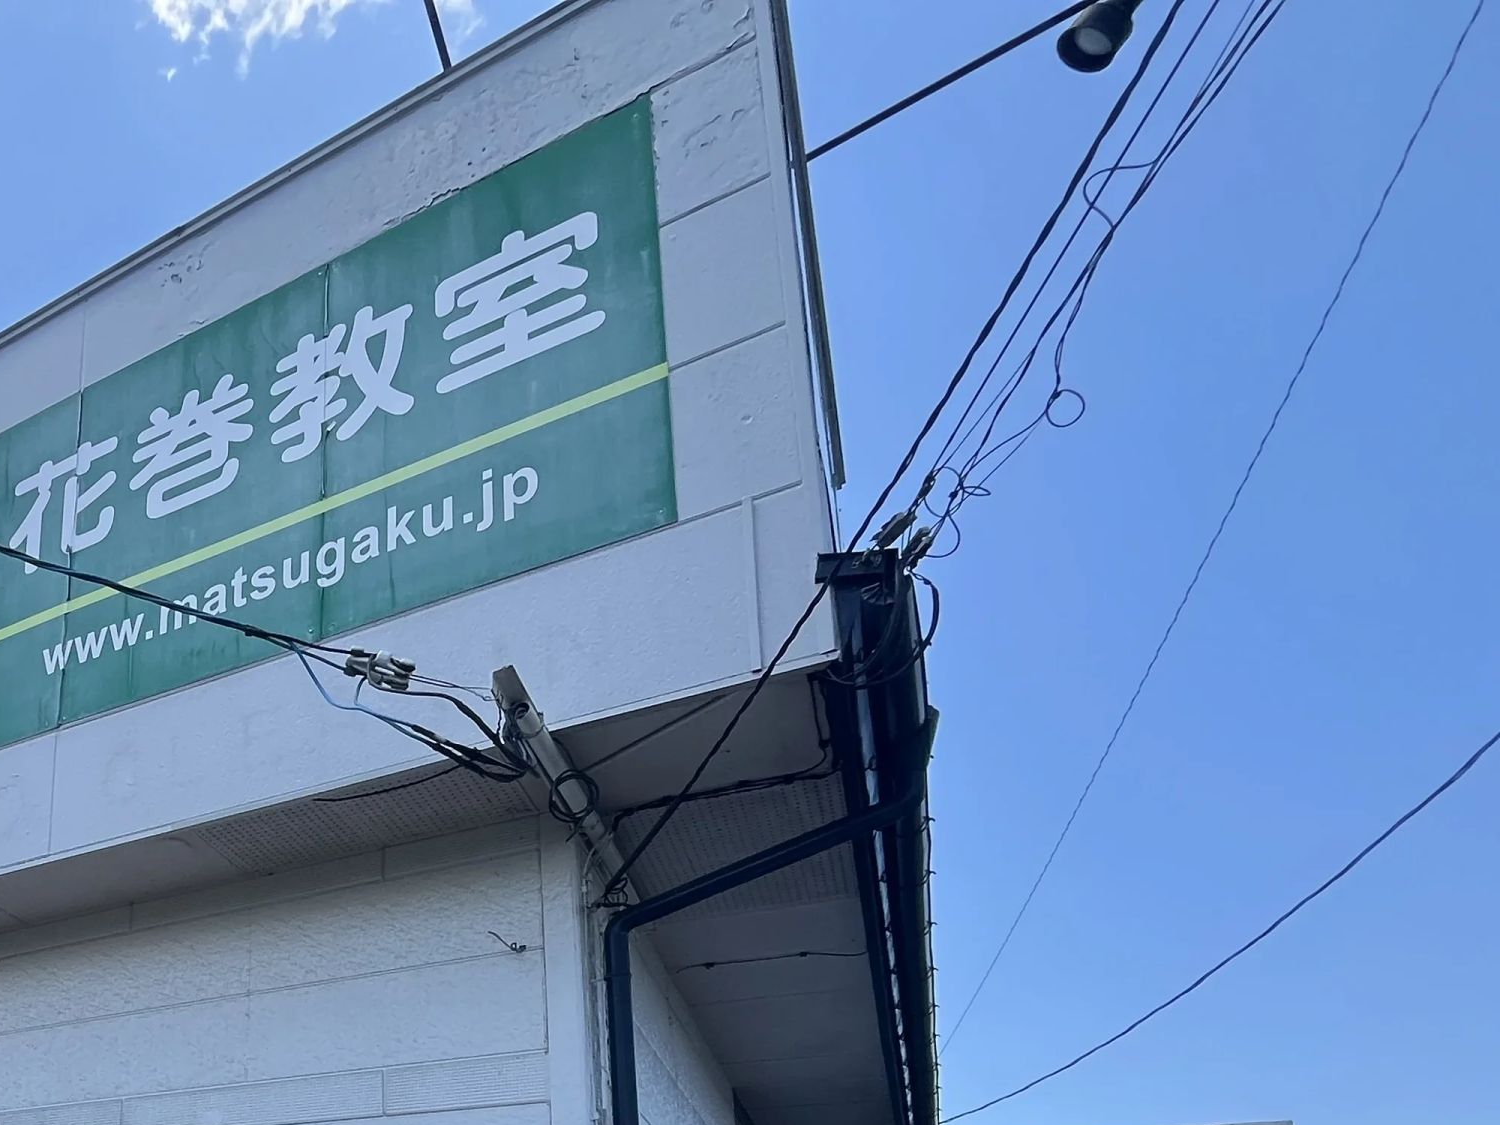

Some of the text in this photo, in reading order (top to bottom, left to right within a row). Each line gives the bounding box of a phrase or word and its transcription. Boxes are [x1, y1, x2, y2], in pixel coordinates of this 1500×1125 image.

[8, 210, 607, 575] 花巻教室
[42, 462, 540, 675] www.matsugaku.jp
